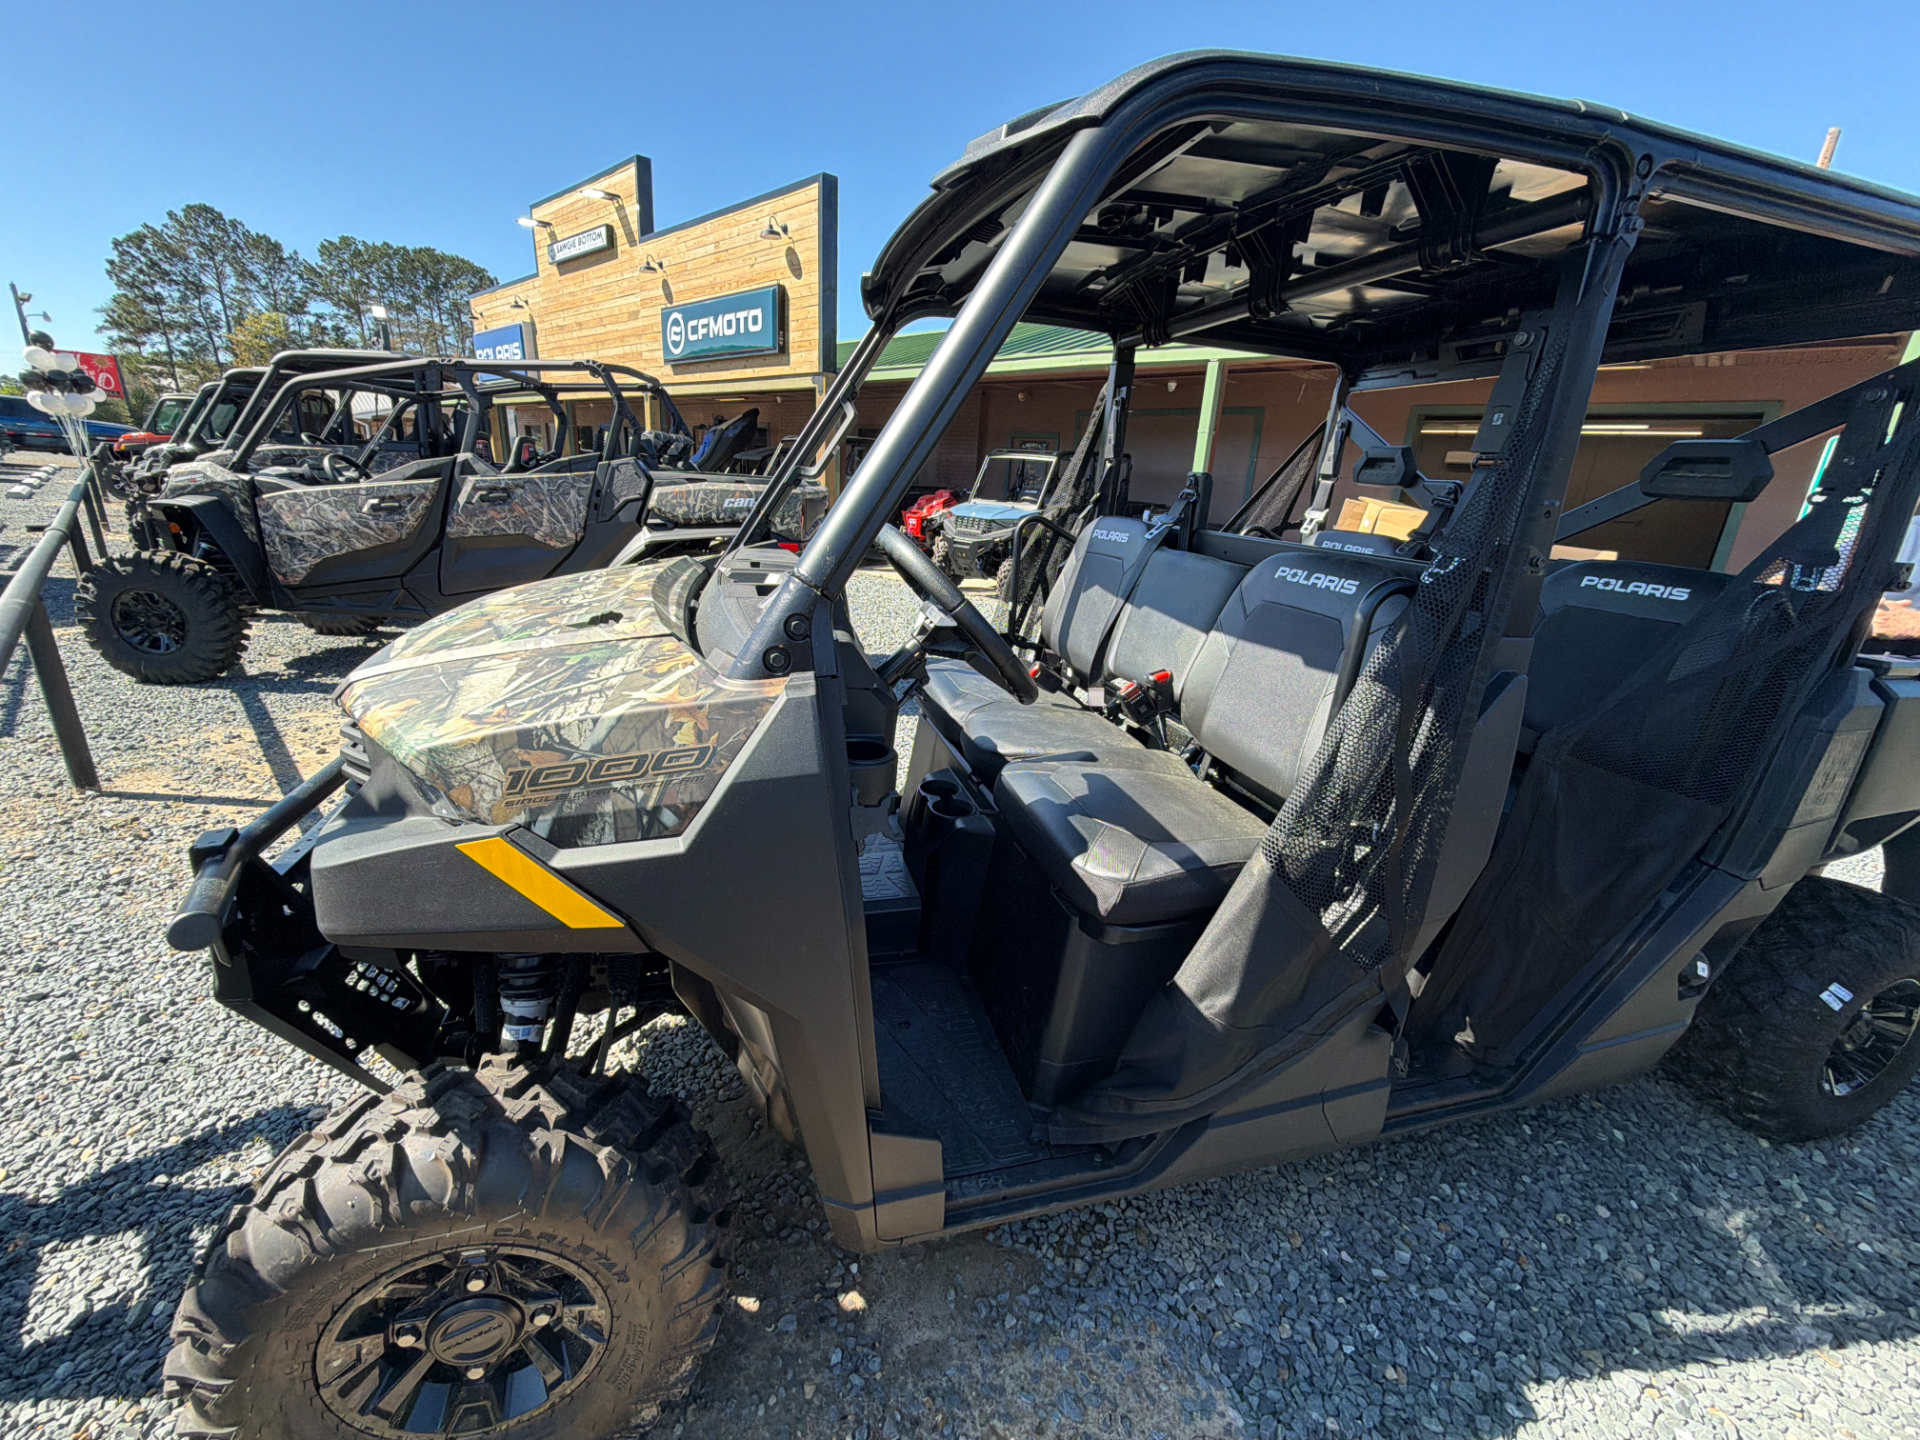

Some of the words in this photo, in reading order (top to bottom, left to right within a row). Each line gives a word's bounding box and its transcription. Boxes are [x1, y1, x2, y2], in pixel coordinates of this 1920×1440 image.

[556, 239, 577, 254] SAWGIE
[578, 230, 605, 246] BOTTOM
[688, 308, 762, 341] CFMOTO
[476, 341, 521, 360] POLARIS
[1092, 528, 1128, 543] POLARIS
[1322, 540, 1375, 554] POLARIS
[1274, 566, 1360, 595] POLARIS
[1579, 575, 1691, 601] POLARIS
[504, 745, 716, 796] 1000
[504, 795, 566, 808] SINGLE
